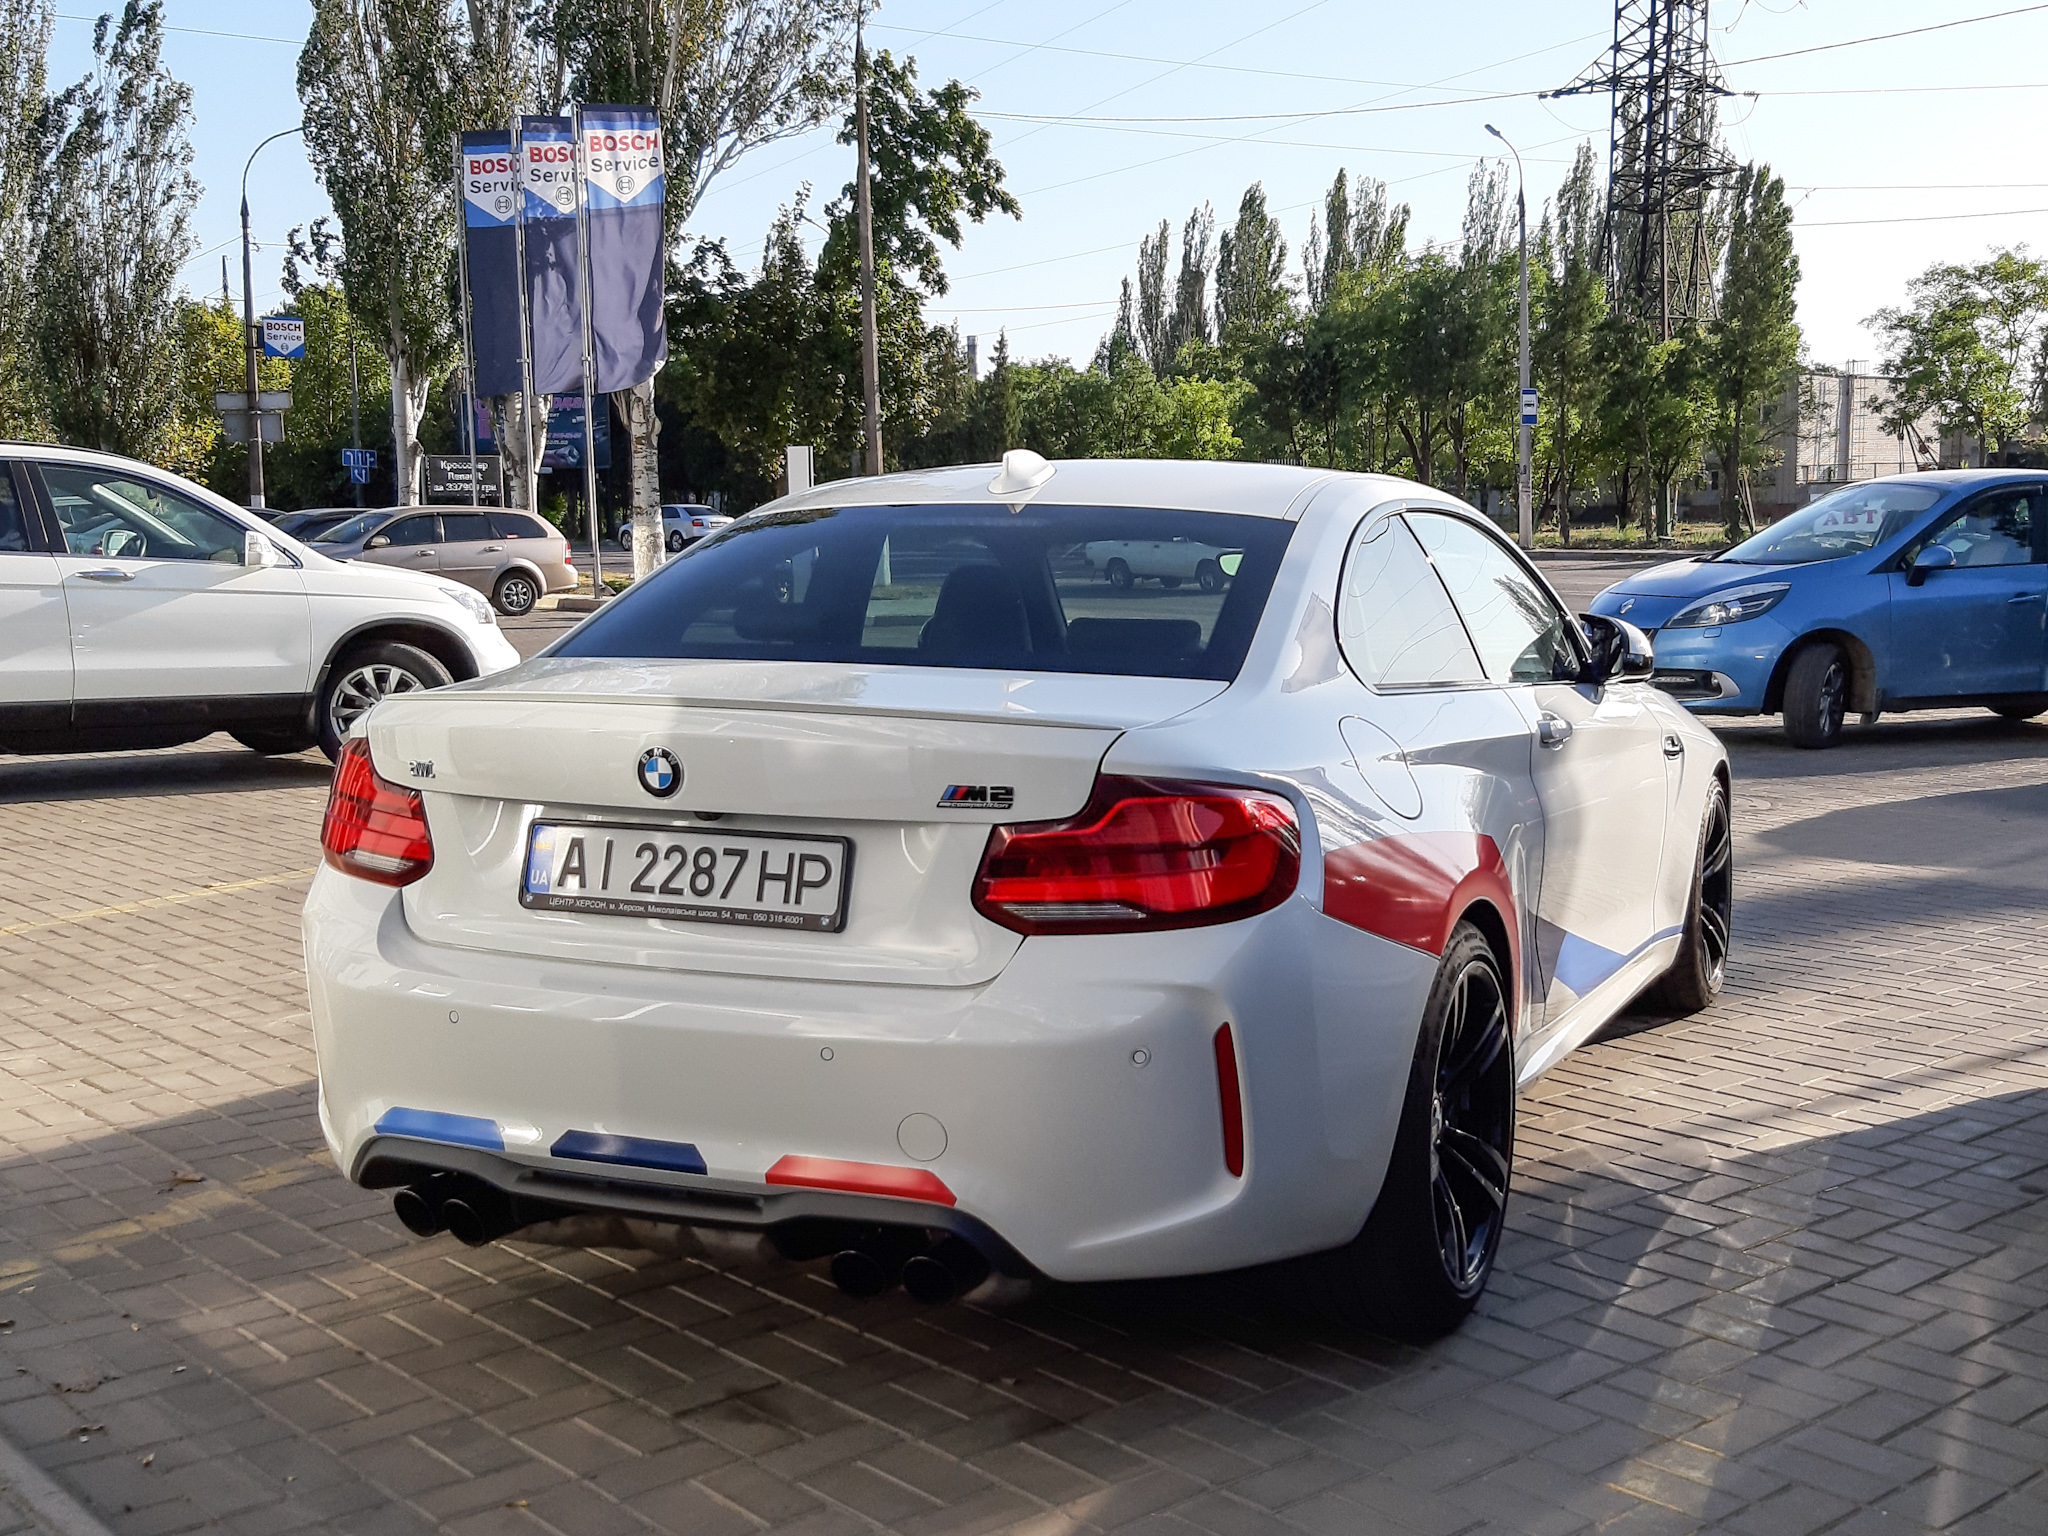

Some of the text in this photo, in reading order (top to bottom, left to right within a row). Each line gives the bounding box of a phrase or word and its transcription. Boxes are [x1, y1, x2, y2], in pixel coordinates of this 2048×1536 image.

[590, 133, 658, 152] BOSCH
[591, 155, 659, 172] Service
[266, 322, 301, 331] BOSCH
[266, 332, 302, 341] Service
[440, 460, 488, 471] Кроссоер
[641, 748, 678, 765] BMW
[530, 869, 548, 886] UA
[630, 842, 749, 900] 2287
[756, 850, 832, 905] HP
[549, 897, 574, 907] ЦЕНТР
[618, 903, 645, 913] Херсон,
[752, 913, 767, 922] 050
[769, 914, 804, 924] 318-6001
